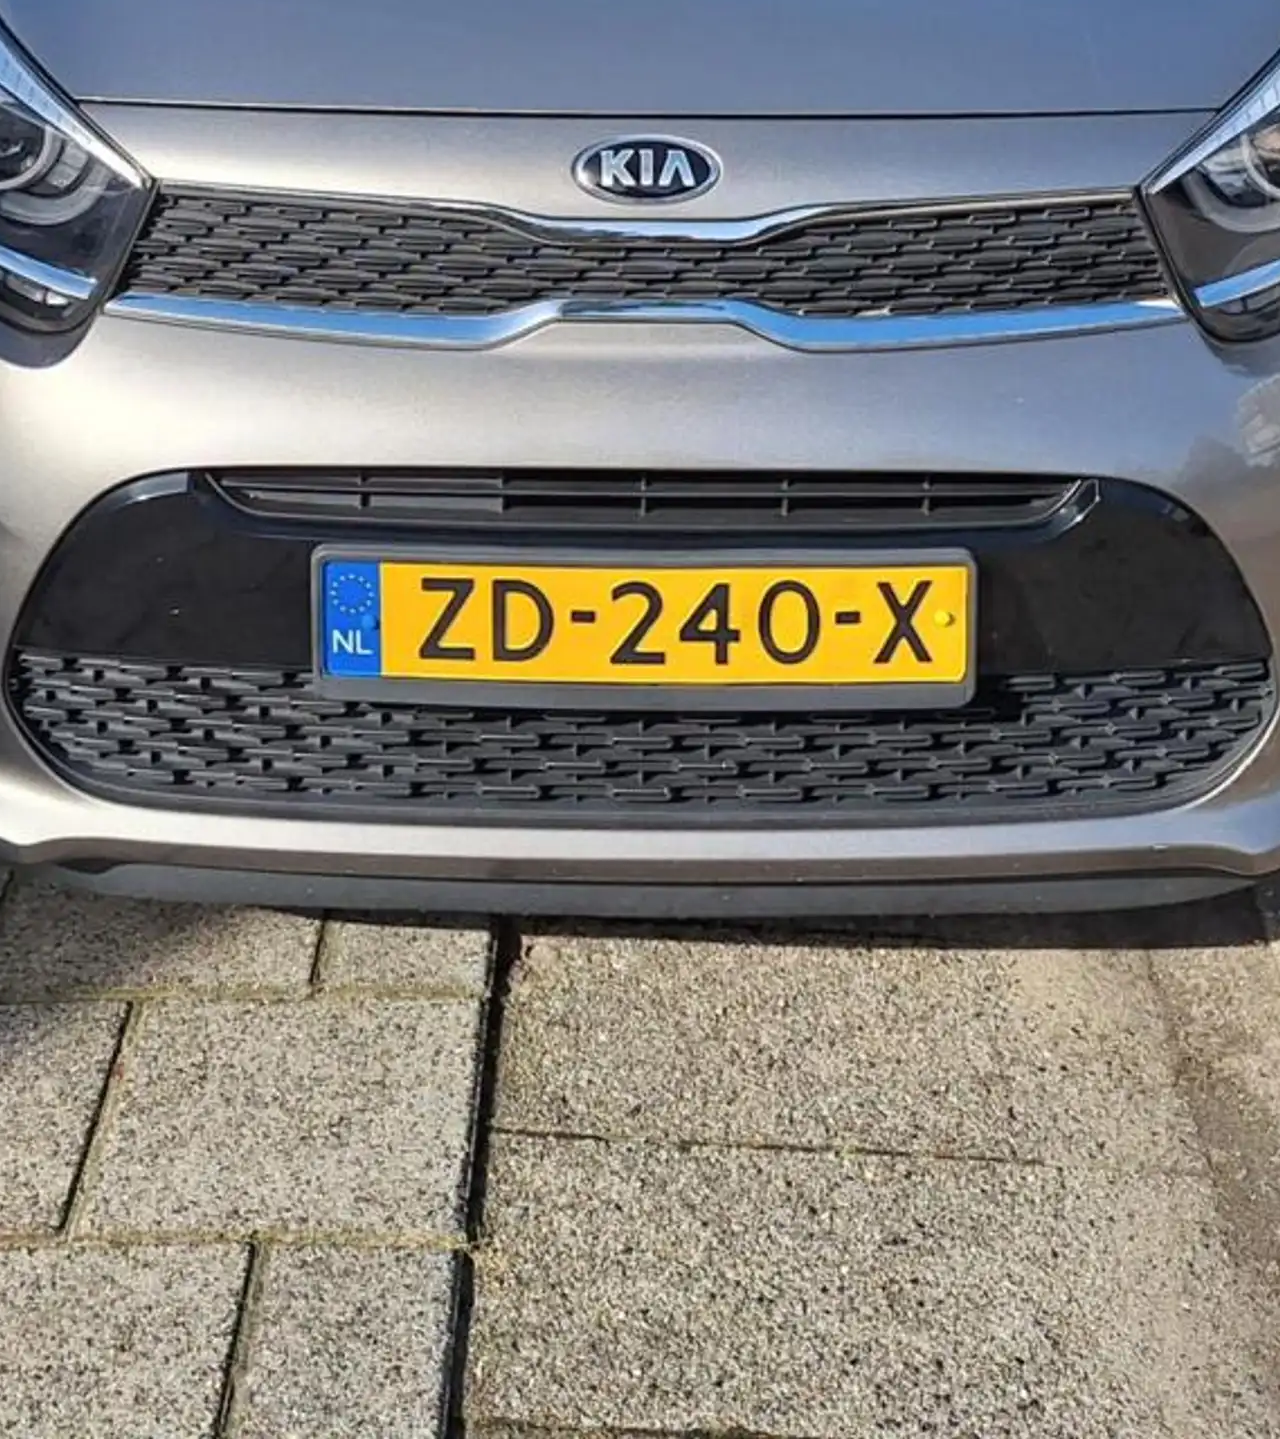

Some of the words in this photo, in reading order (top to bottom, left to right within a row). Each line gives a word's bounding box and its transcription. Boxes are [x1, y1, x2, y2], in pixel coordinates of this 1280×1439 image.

[600, 147, 697, 187] KIA
[332, 628, 372, 655] NL
[418, 575, 934, 666] ZD-240-X
